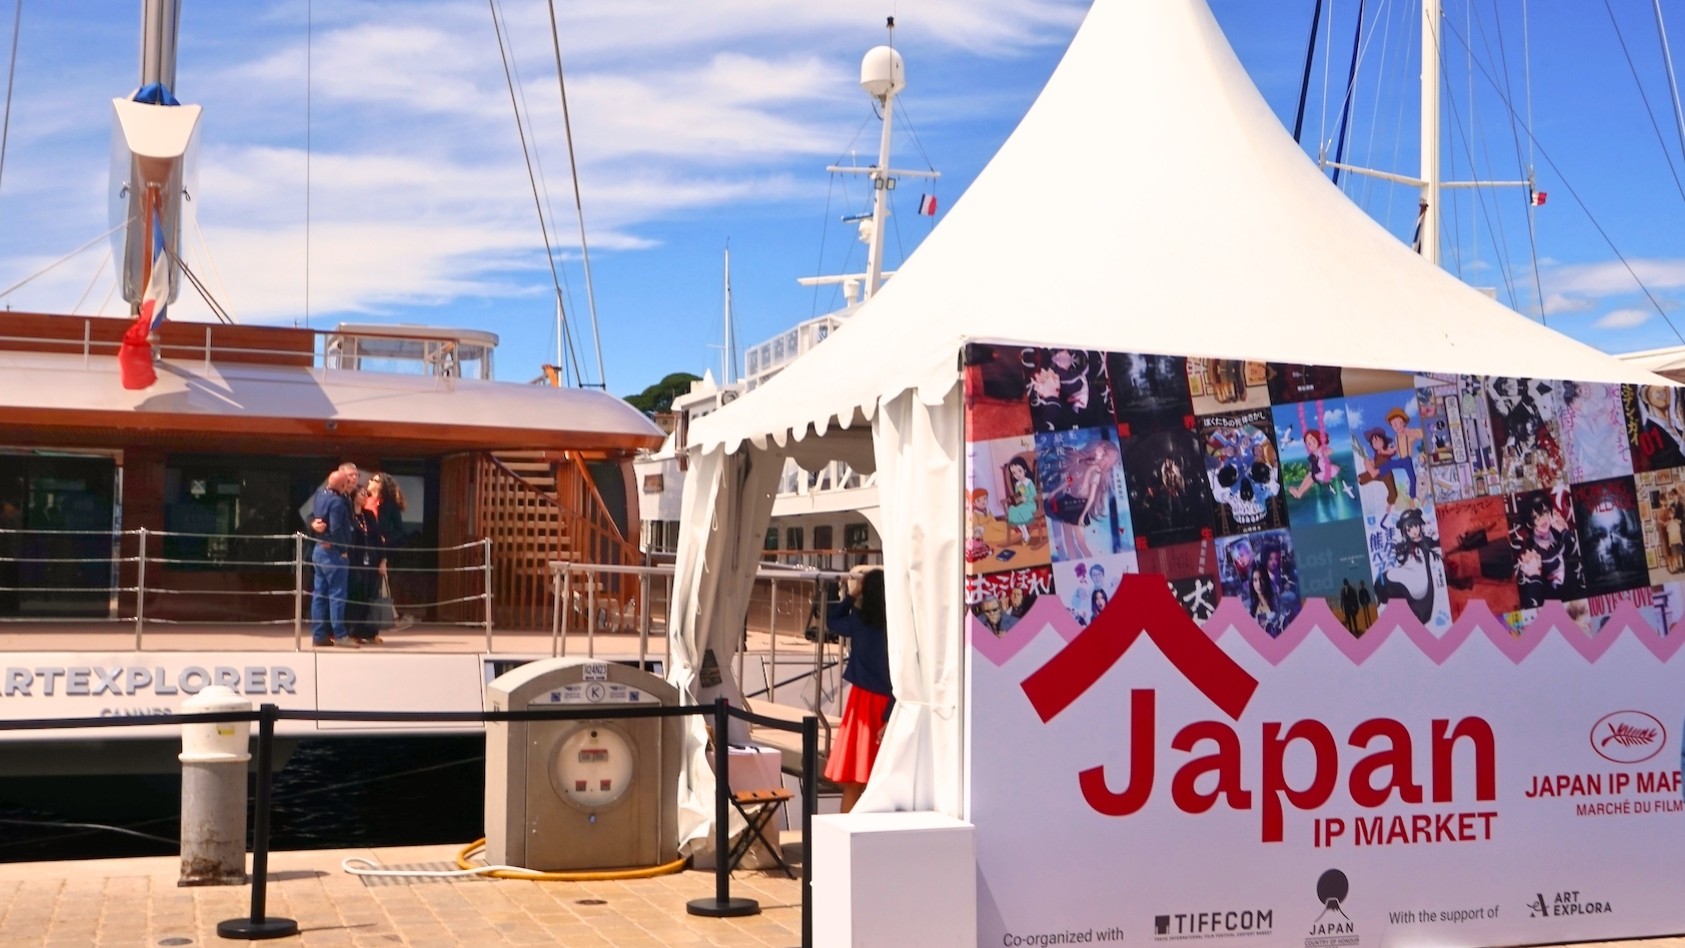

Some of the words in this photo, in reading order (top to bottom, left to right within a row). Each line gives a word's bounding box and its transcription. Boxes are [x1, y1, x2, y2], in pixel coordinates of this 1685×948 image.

[1641, 426, 1665, 457] 01
[1297, 548, 1333, 569] Lost
[0, 666, 296, 697] RTEXPLORER
[1079, 688, 1496, 842] Japan
[1525, 774, 1601, 798] JAPAN
[1609, 773, 1630, 795] IP
[1576, 799, 1631, 816] MARCHÉ
[1634, 801, 1651, 814] DU
[1655, 800, 1684, 812] FILM
[1314, 818, 1345, 848] IP
[1355, 812, 1498, 846] MARKET
[1553, 901, 1612, 916] EXPLORA
[1554, 891, 1580, 904] ART
[1174, 909, 1273, 934] TIFFCOM
[1389, 910, 1415, 924] With
[1418, 909, 1437, 923] the
[1440, 907, 1484, 924] support
[1487, 905, 1500, 919] of
[1003, 928, 1093, 948] Co-organized
[1096, 926, 1124, 941] with
[1309, 922, 1354, 935] JAPAN
